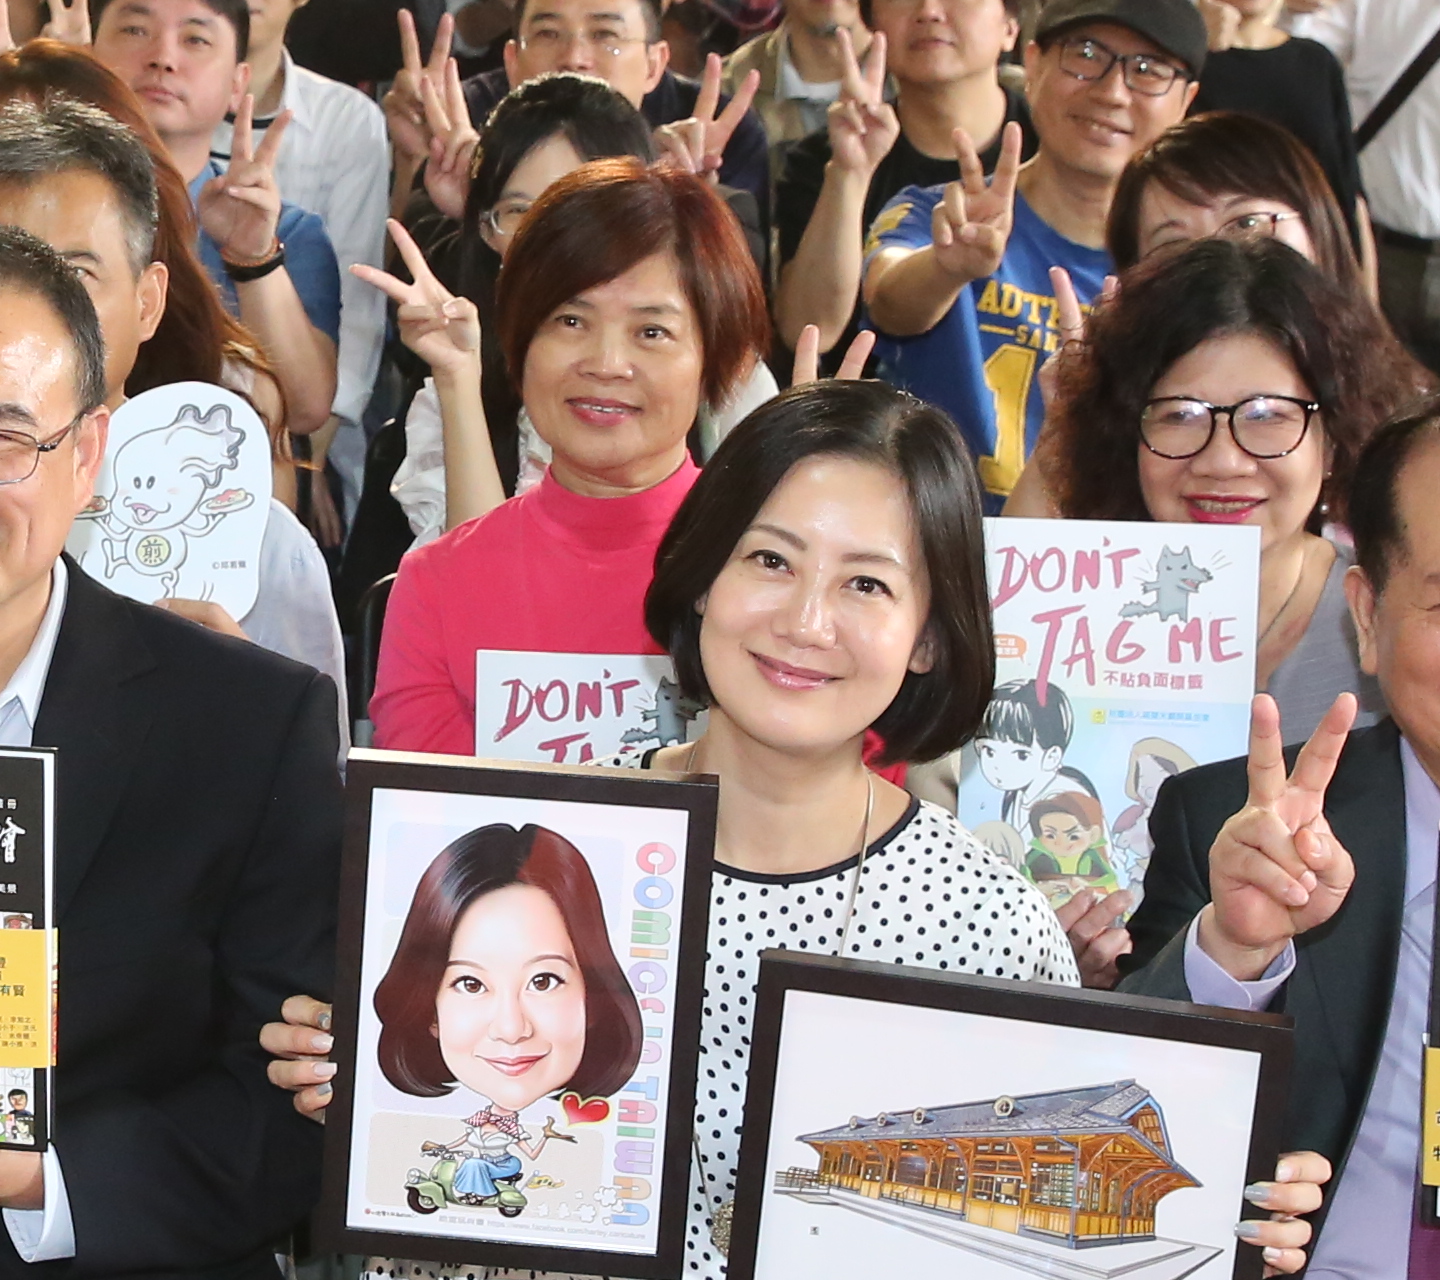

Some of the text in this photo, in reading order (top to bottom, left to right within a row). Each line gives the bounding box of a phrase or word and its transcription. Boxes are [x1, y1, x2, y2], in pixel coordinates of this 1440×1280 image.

[991, 536, 1141, 610] DON'T
[1032, 604, 1243, 708] TAG ME
[1103, 670, 1204, 690] 不貼負面標籤
[493, 669, 641, 742] DON'T
